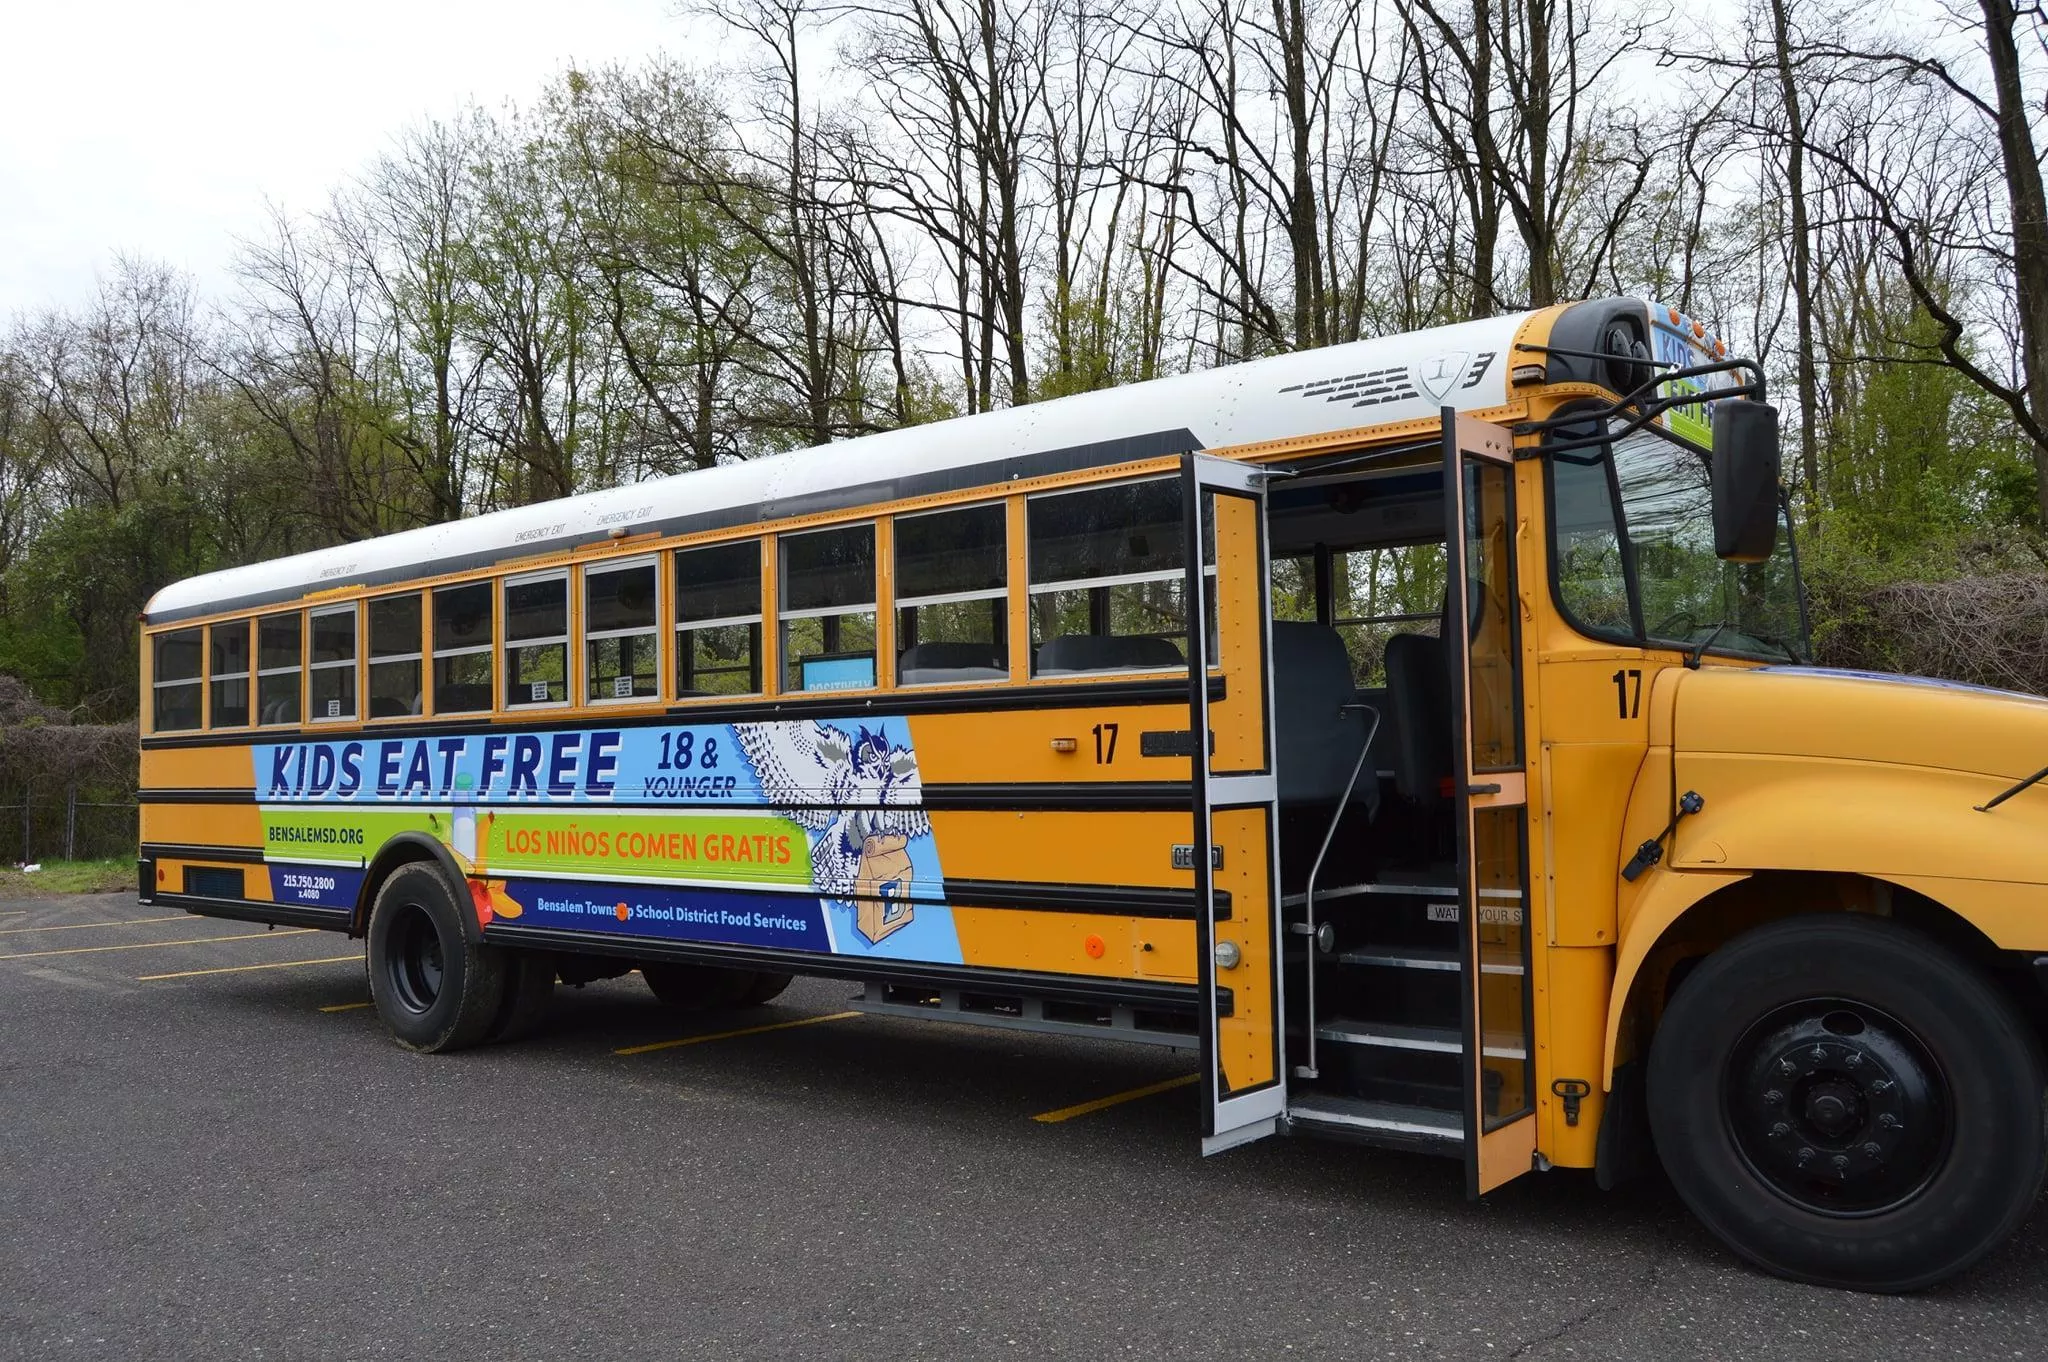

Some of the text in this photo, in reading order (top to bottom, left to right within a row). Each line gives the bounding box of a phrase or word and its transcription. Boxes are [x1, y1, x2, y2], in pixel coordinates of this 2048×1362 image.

[597, 506, 653, 526] EMERGENCY EXIT
[515, 523, 566, 543] EMERGENCY EXIT
[1612, 669, 1642, 719] 17
[657, 731, 718, 770] 18 &
[1092, 723, 1118, 764] 17
[268, 731, 621, 798] KIDS EAT FREE
[643, 776, 737, 799] YOUNGER
[269, 826, 364, 845] BENSALEMSD.ORG
[505, 823, 791, 865] LOS NIÑOS COMEN GRATIS
[283, 874, 335, 890] 215.750.2800
[537, 897, 807, 932] Bensalem Townsp School District Food Services
[1435, 906, 1458, 920] WAT
[1479, 909, 1508, 921] YOUR
